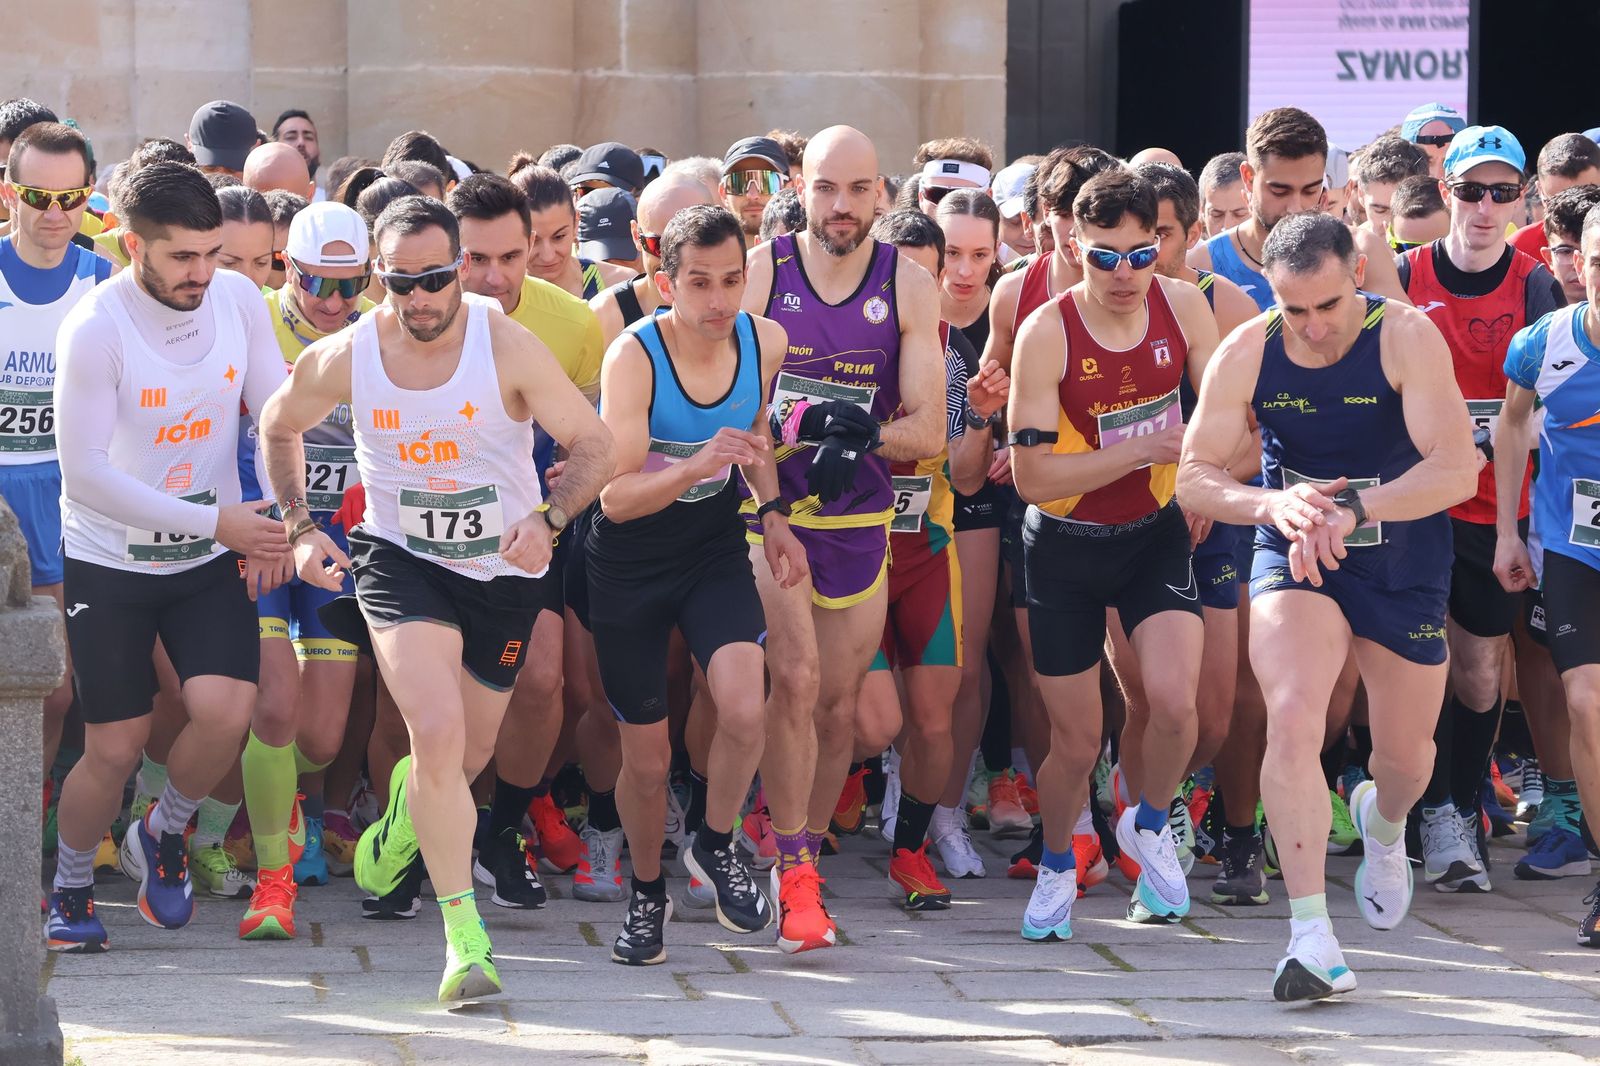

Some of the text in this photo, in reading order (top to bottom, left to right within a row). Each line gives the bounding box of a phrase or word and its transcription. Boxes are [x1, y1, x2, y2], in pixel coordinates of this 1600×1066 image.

[165, 329, 200, 346] AEROFIT
[834, 360, 876, 375] PRIM
[0, 406, 54, 434] 256
[419, 509, 484, 540] 173
[1057, 511, 1159, 538] NIKE PRO
